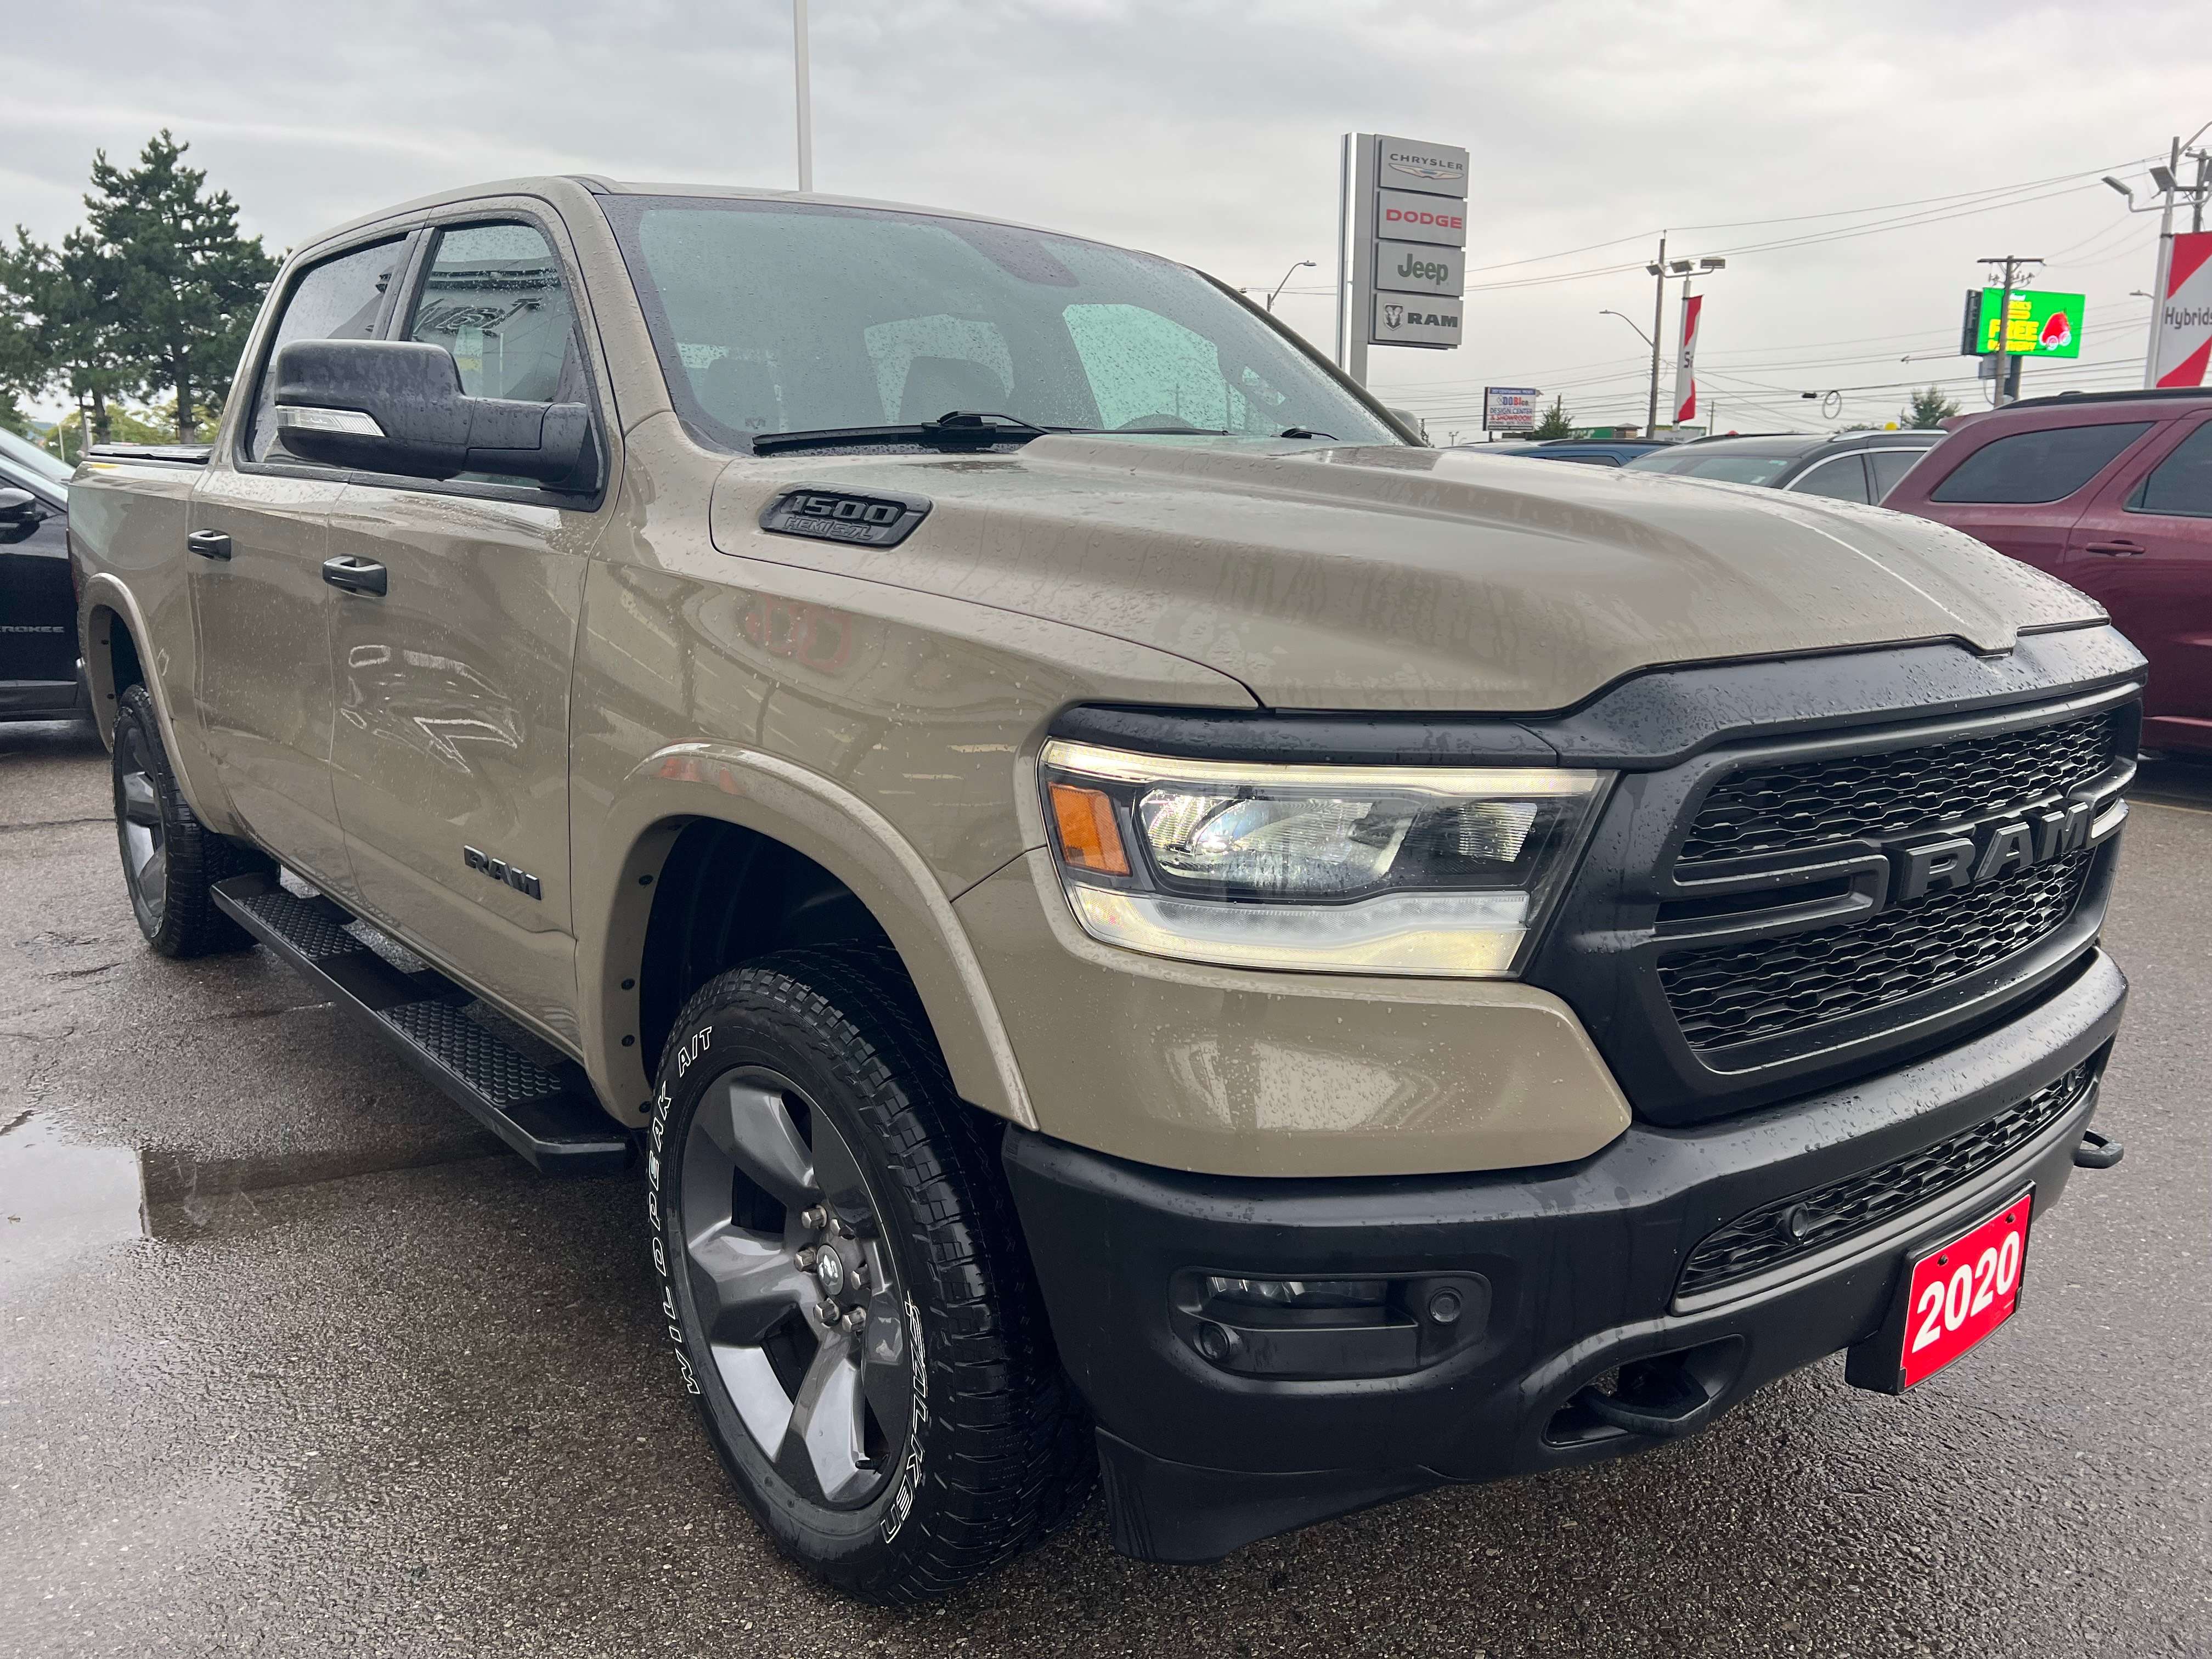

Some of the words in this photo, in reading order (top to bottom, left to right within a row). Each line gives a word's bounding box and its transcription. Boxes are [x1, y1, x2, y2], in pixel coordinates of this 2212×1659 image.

[1390, 153, 1463, 171] CHRYSLER
[1386, 208, 1462, 229] DODGE
[1397, 253, 1448, 285] Jeep
[1407, 312, 1458, 328] RAM
[789, 495, 900, 523] 1500
[1900, 801, 2088, 901] RAM
[464, 845, 544, 901] RAM
[1911, 1231, 2020, 1354] 2020
